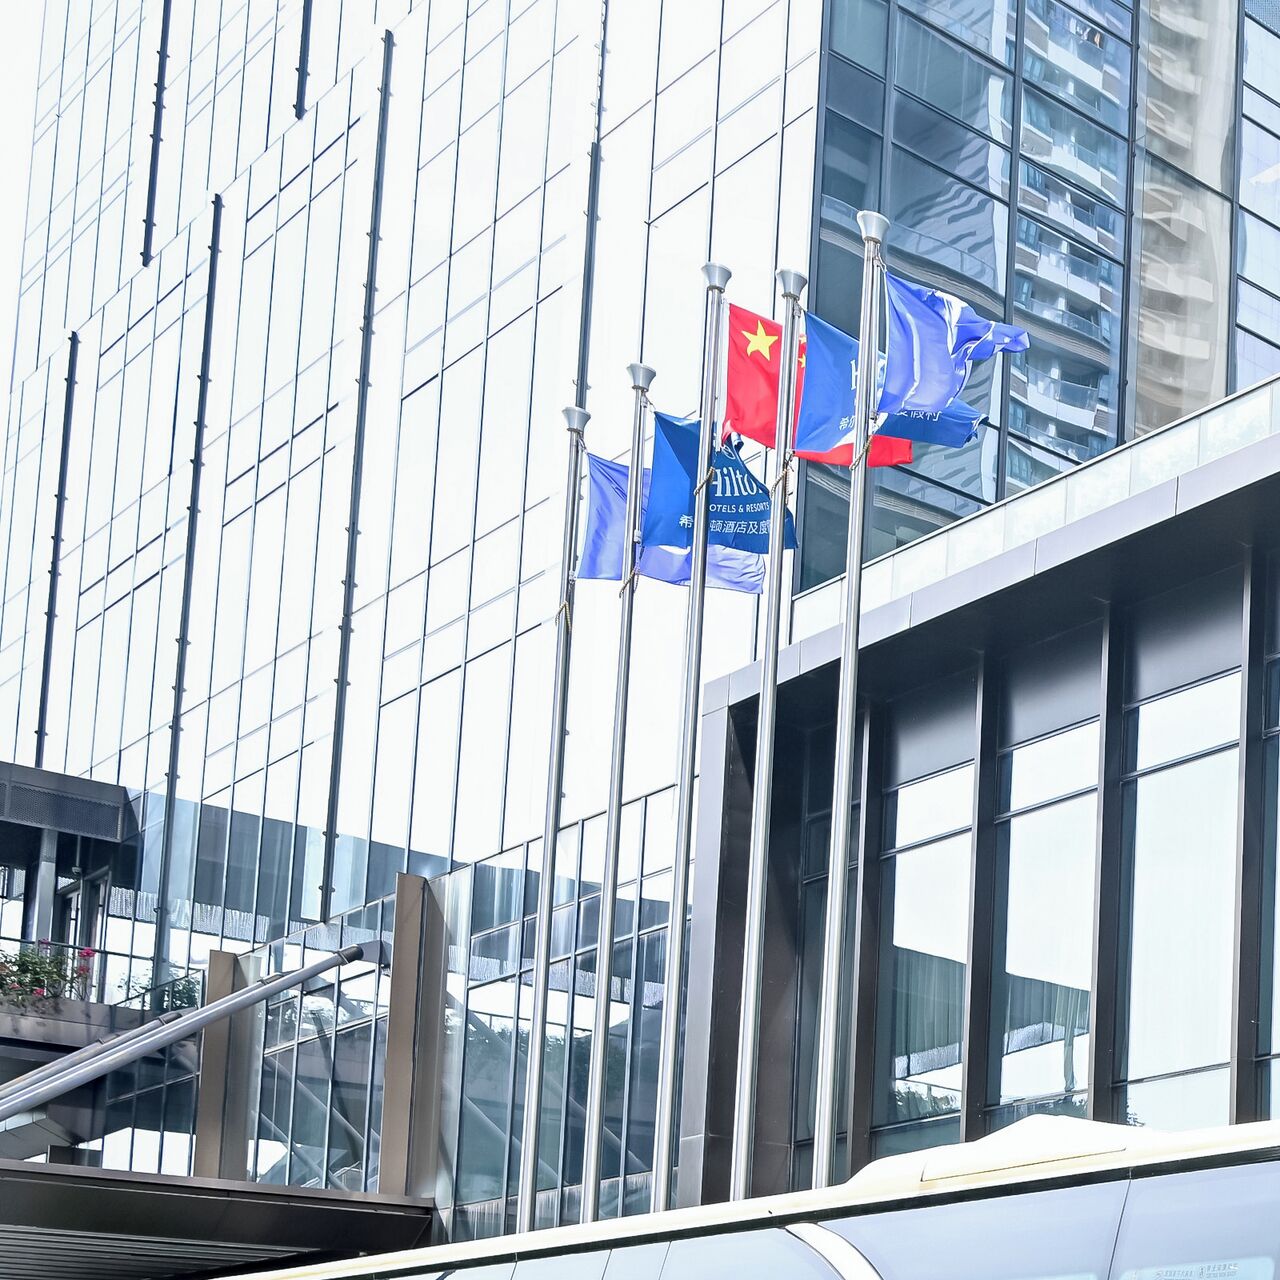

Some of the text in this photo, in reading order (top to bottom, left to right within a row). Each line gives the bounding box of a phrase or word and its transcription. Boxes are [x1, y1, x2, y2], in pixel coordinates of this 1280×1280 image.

[712, 466, 763, 497] Hilto
[738, 504, 744, 512] &
[746, 501, 770, 513] RESORTS
